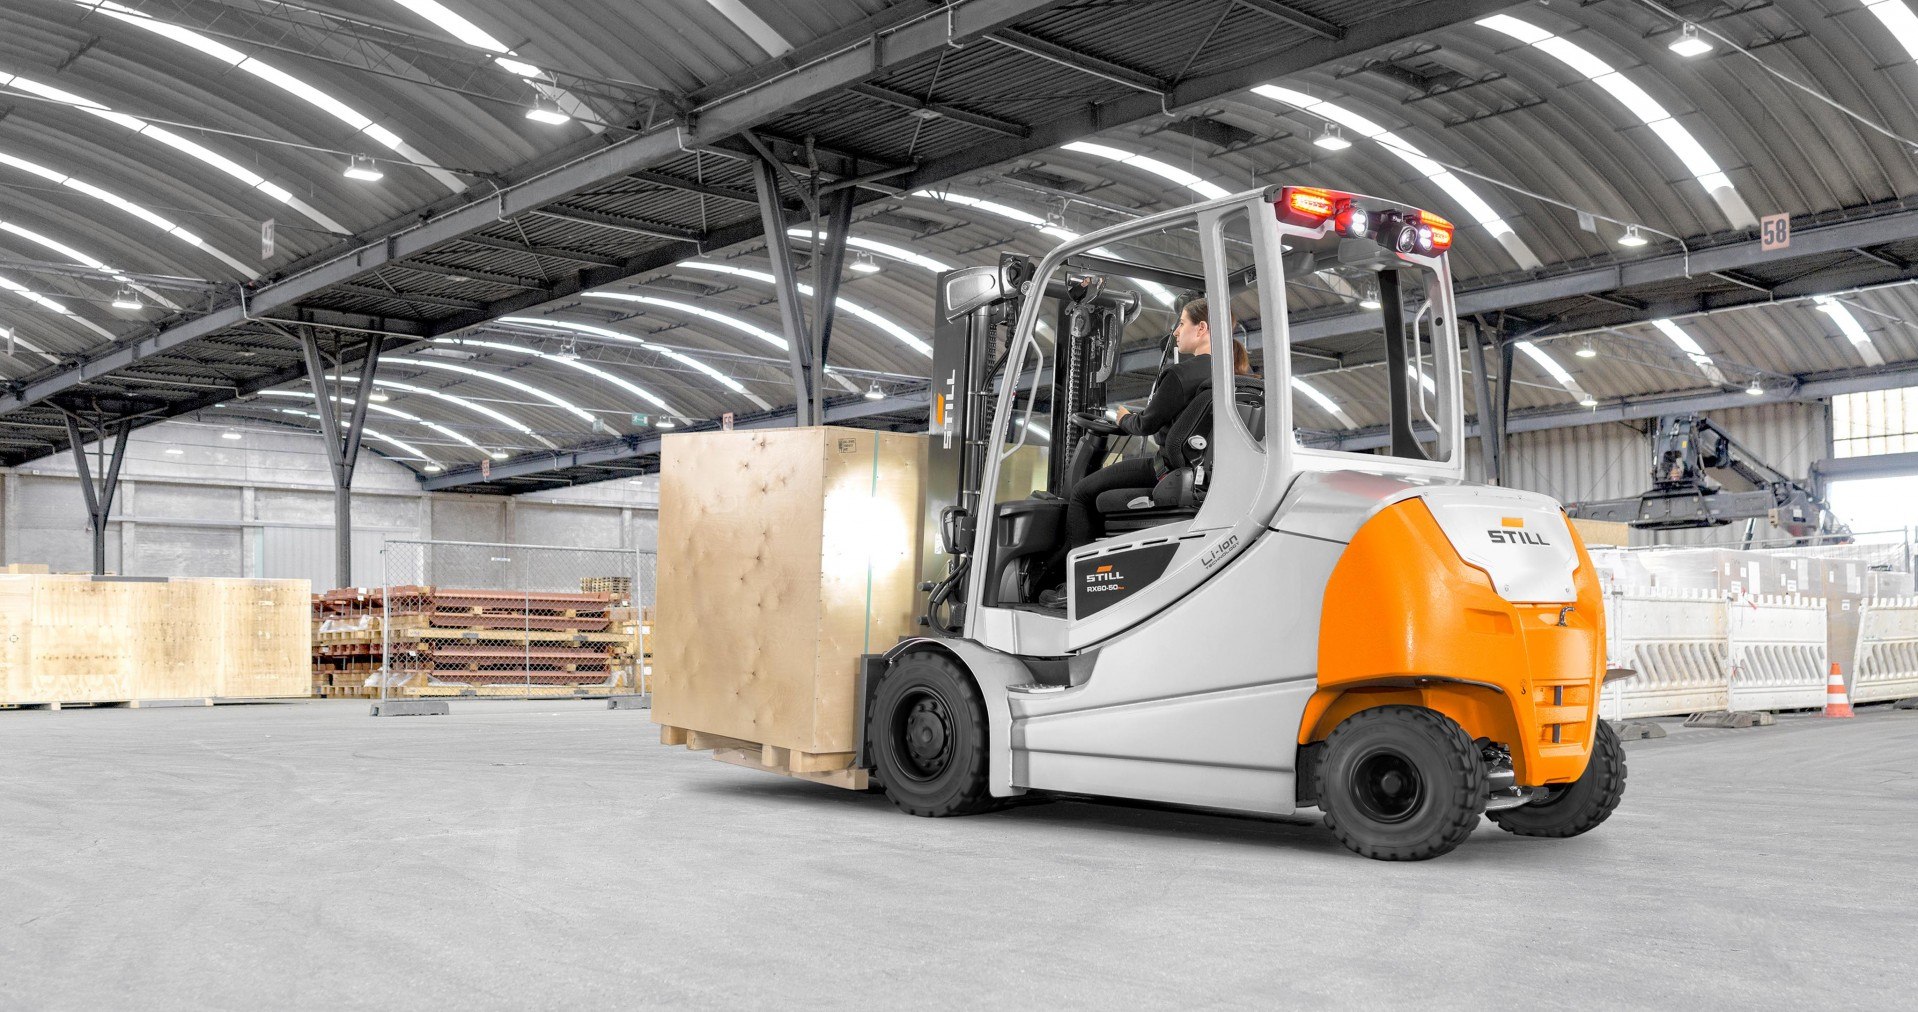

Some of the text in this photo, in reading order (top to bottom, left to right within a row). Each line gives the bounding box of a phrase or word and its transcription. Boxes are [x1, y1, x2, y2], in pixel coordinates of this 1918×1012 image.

[1763, 218, 1787, 245] 58
[943, 369, 955, 449] STILL
[1487, 530, 1550, 546] STILL
[1086, 571, 1124, 583] STILL
